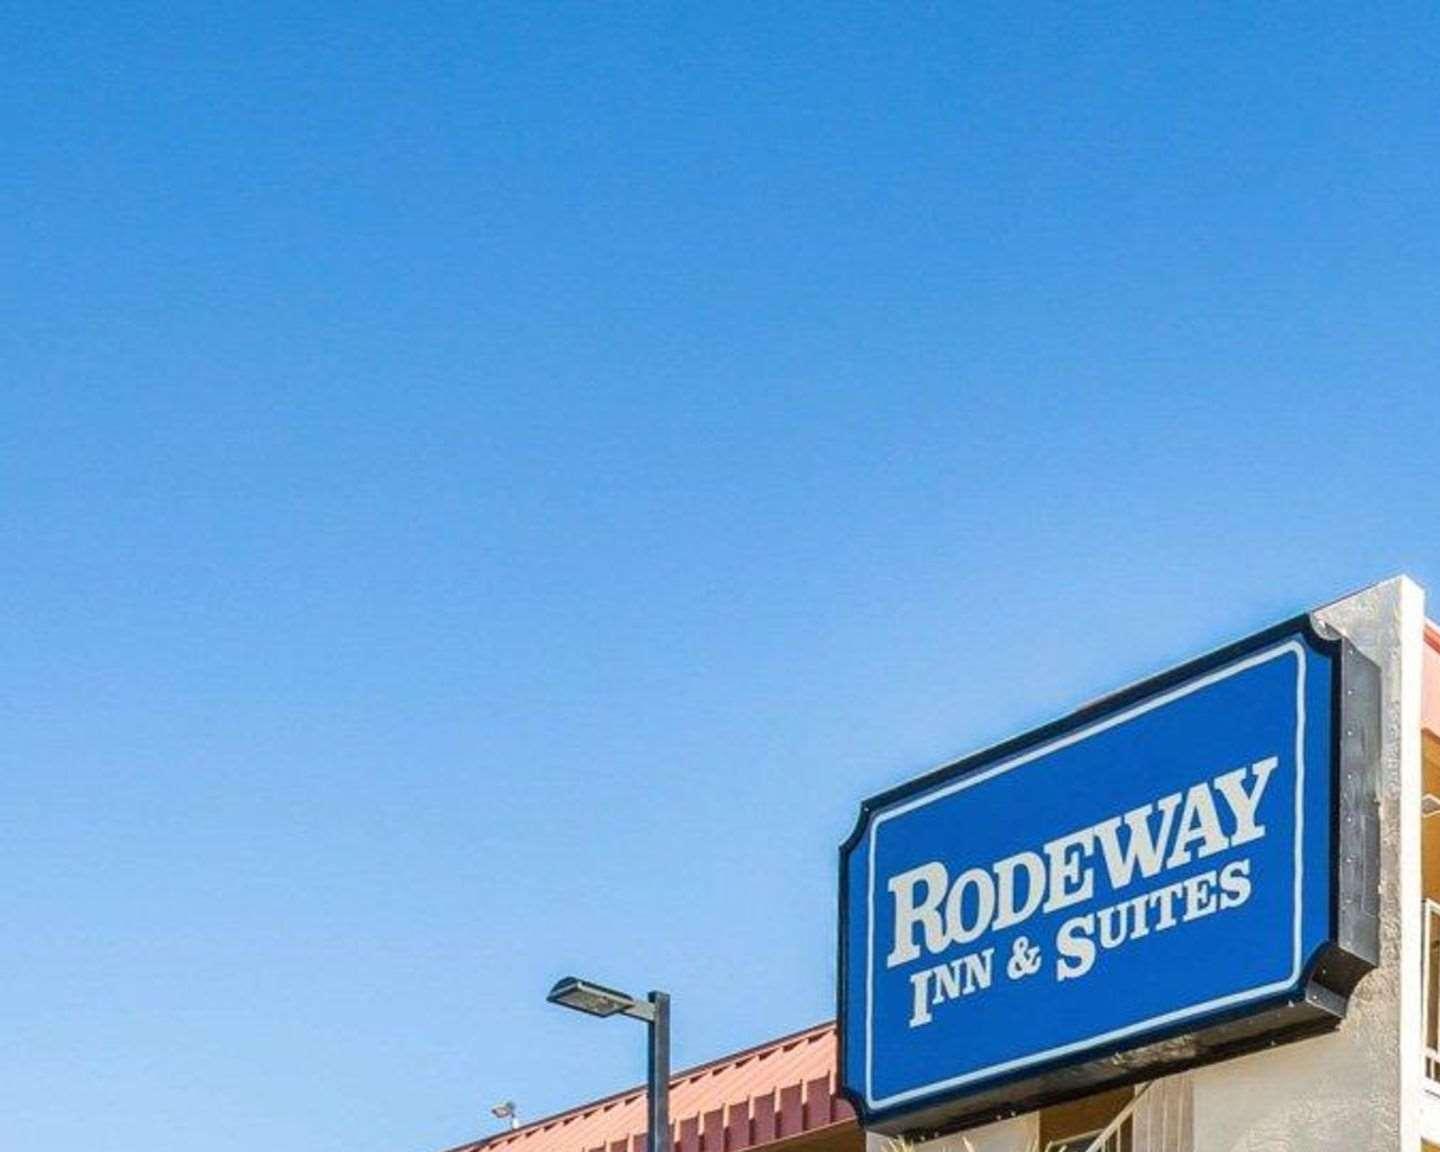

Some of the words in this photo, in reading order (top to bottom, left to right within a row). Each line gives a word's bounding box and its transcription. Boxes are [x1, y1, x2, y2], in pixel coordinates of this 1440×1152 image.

[887, 756, 1278, 968] RODEWAY
[909, 948, 995, 1028] INN
[1007, 936, 1042, 980] &
[1056, 859, 1252, 981] SUITES
